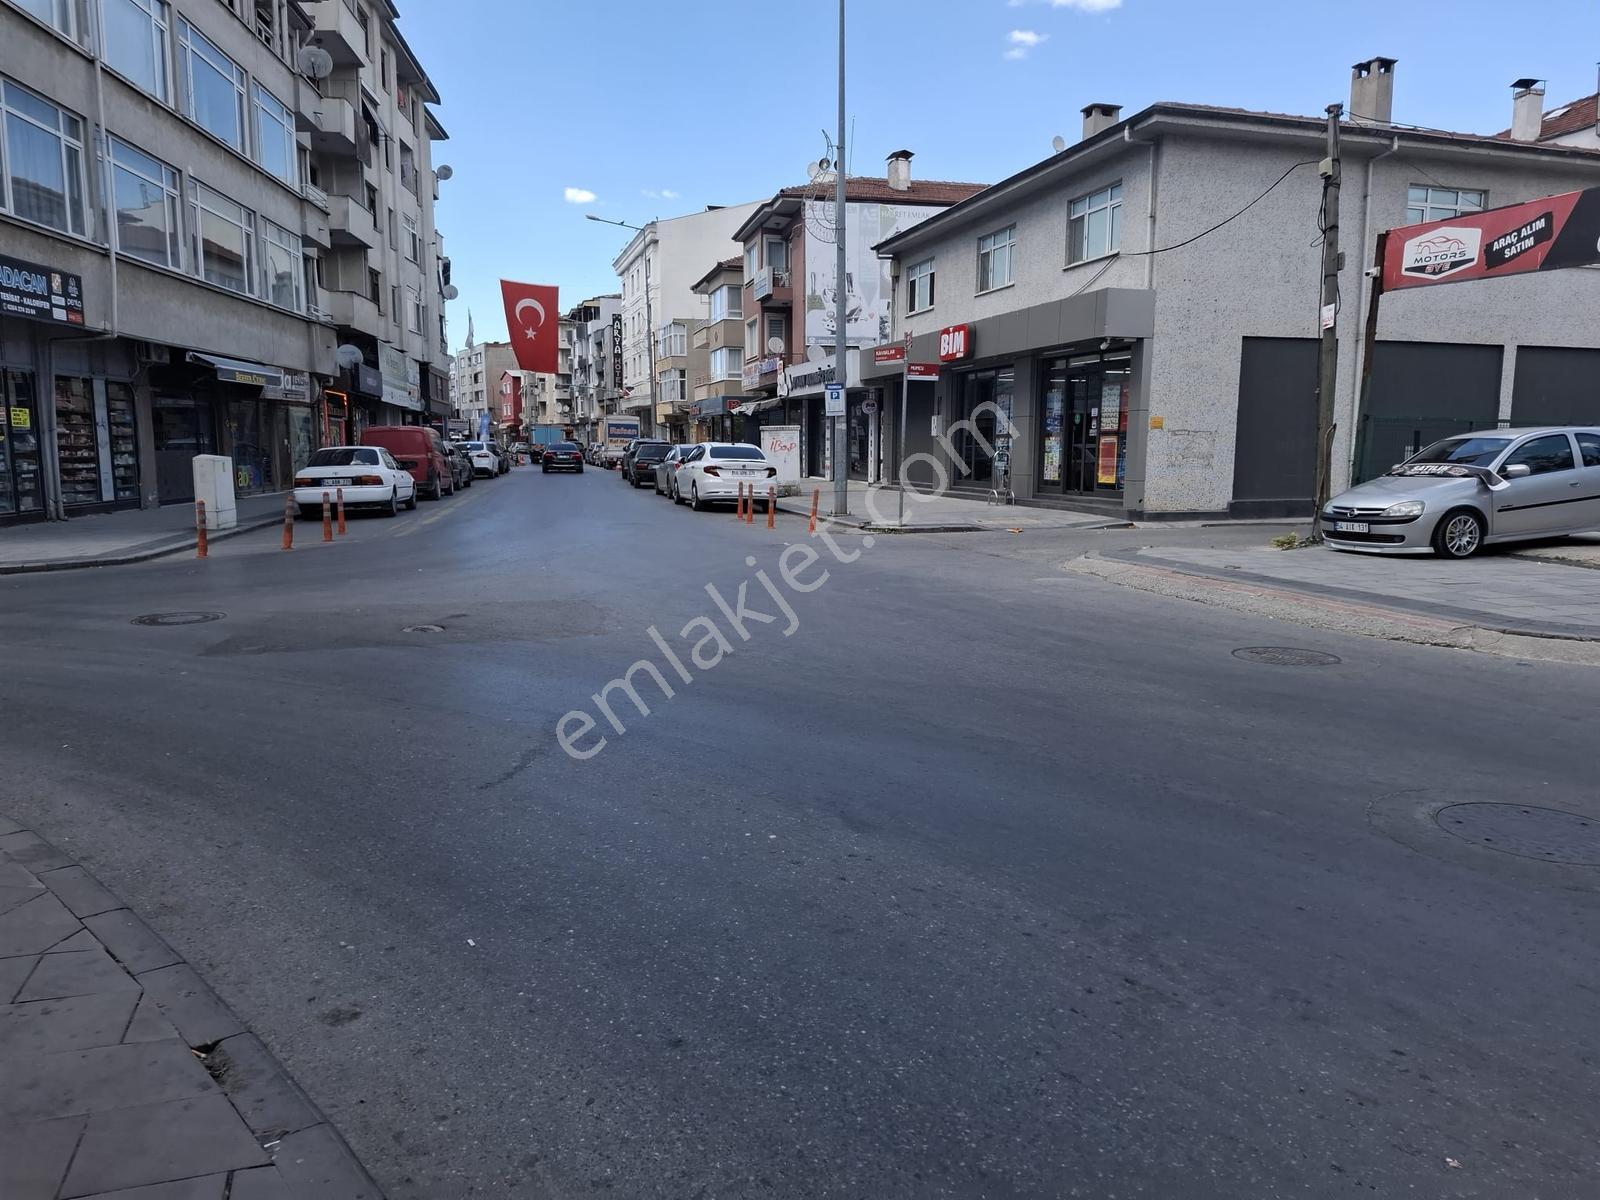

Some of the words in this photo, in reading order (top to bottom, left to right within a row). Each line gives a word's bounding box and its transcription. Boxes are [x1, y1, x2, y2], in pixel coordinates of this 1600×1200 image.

[1493, 232, 1518, 252] ARAÇ
[1521, 218, 1546, 239] ALIM
[1414, 250, 1467, 264] MOTORS
[1504, 237, 1535, 259] SATIM
[940, 327, 965, 356] BİM
